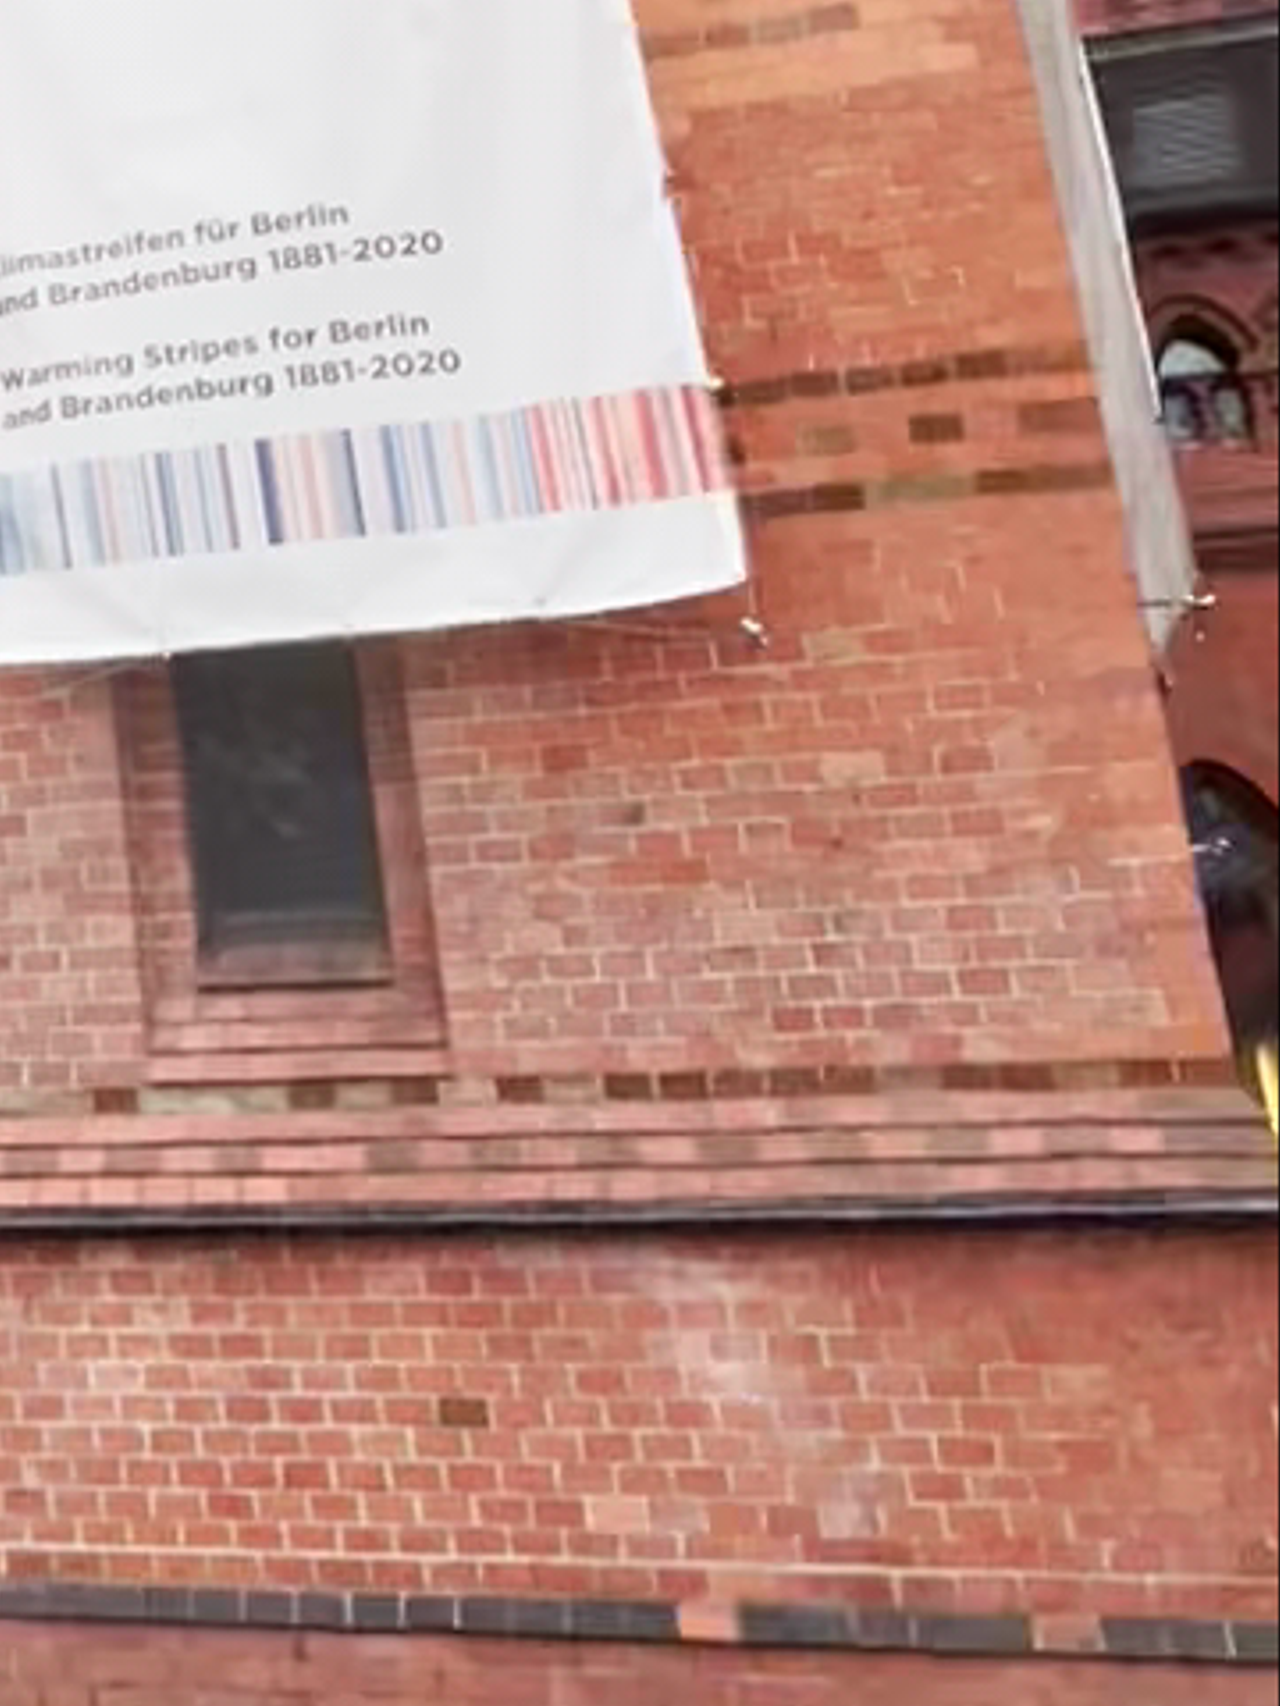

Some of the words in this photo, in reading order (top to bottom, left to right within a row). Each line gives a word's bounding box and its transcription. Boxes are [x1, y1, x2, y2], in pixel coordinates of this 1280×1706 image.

[194, 216, 241, 246] für
[250, 202, 350, 238] Berlin
[48, 251, 258, 306] Brandenburg
[268, 229, 444, 274] 1881-2020
[0, 350, 134, 393] Warming
[143, 332, 259, 370] Stripes
[269, 325, 319, 352] for
[329, 312, 430, 347] Berlin
[2, 399, 52, 431] and
[60, 370, 275, 422] Brandenburg
[285, 348, 461, 390] 1881-2020
